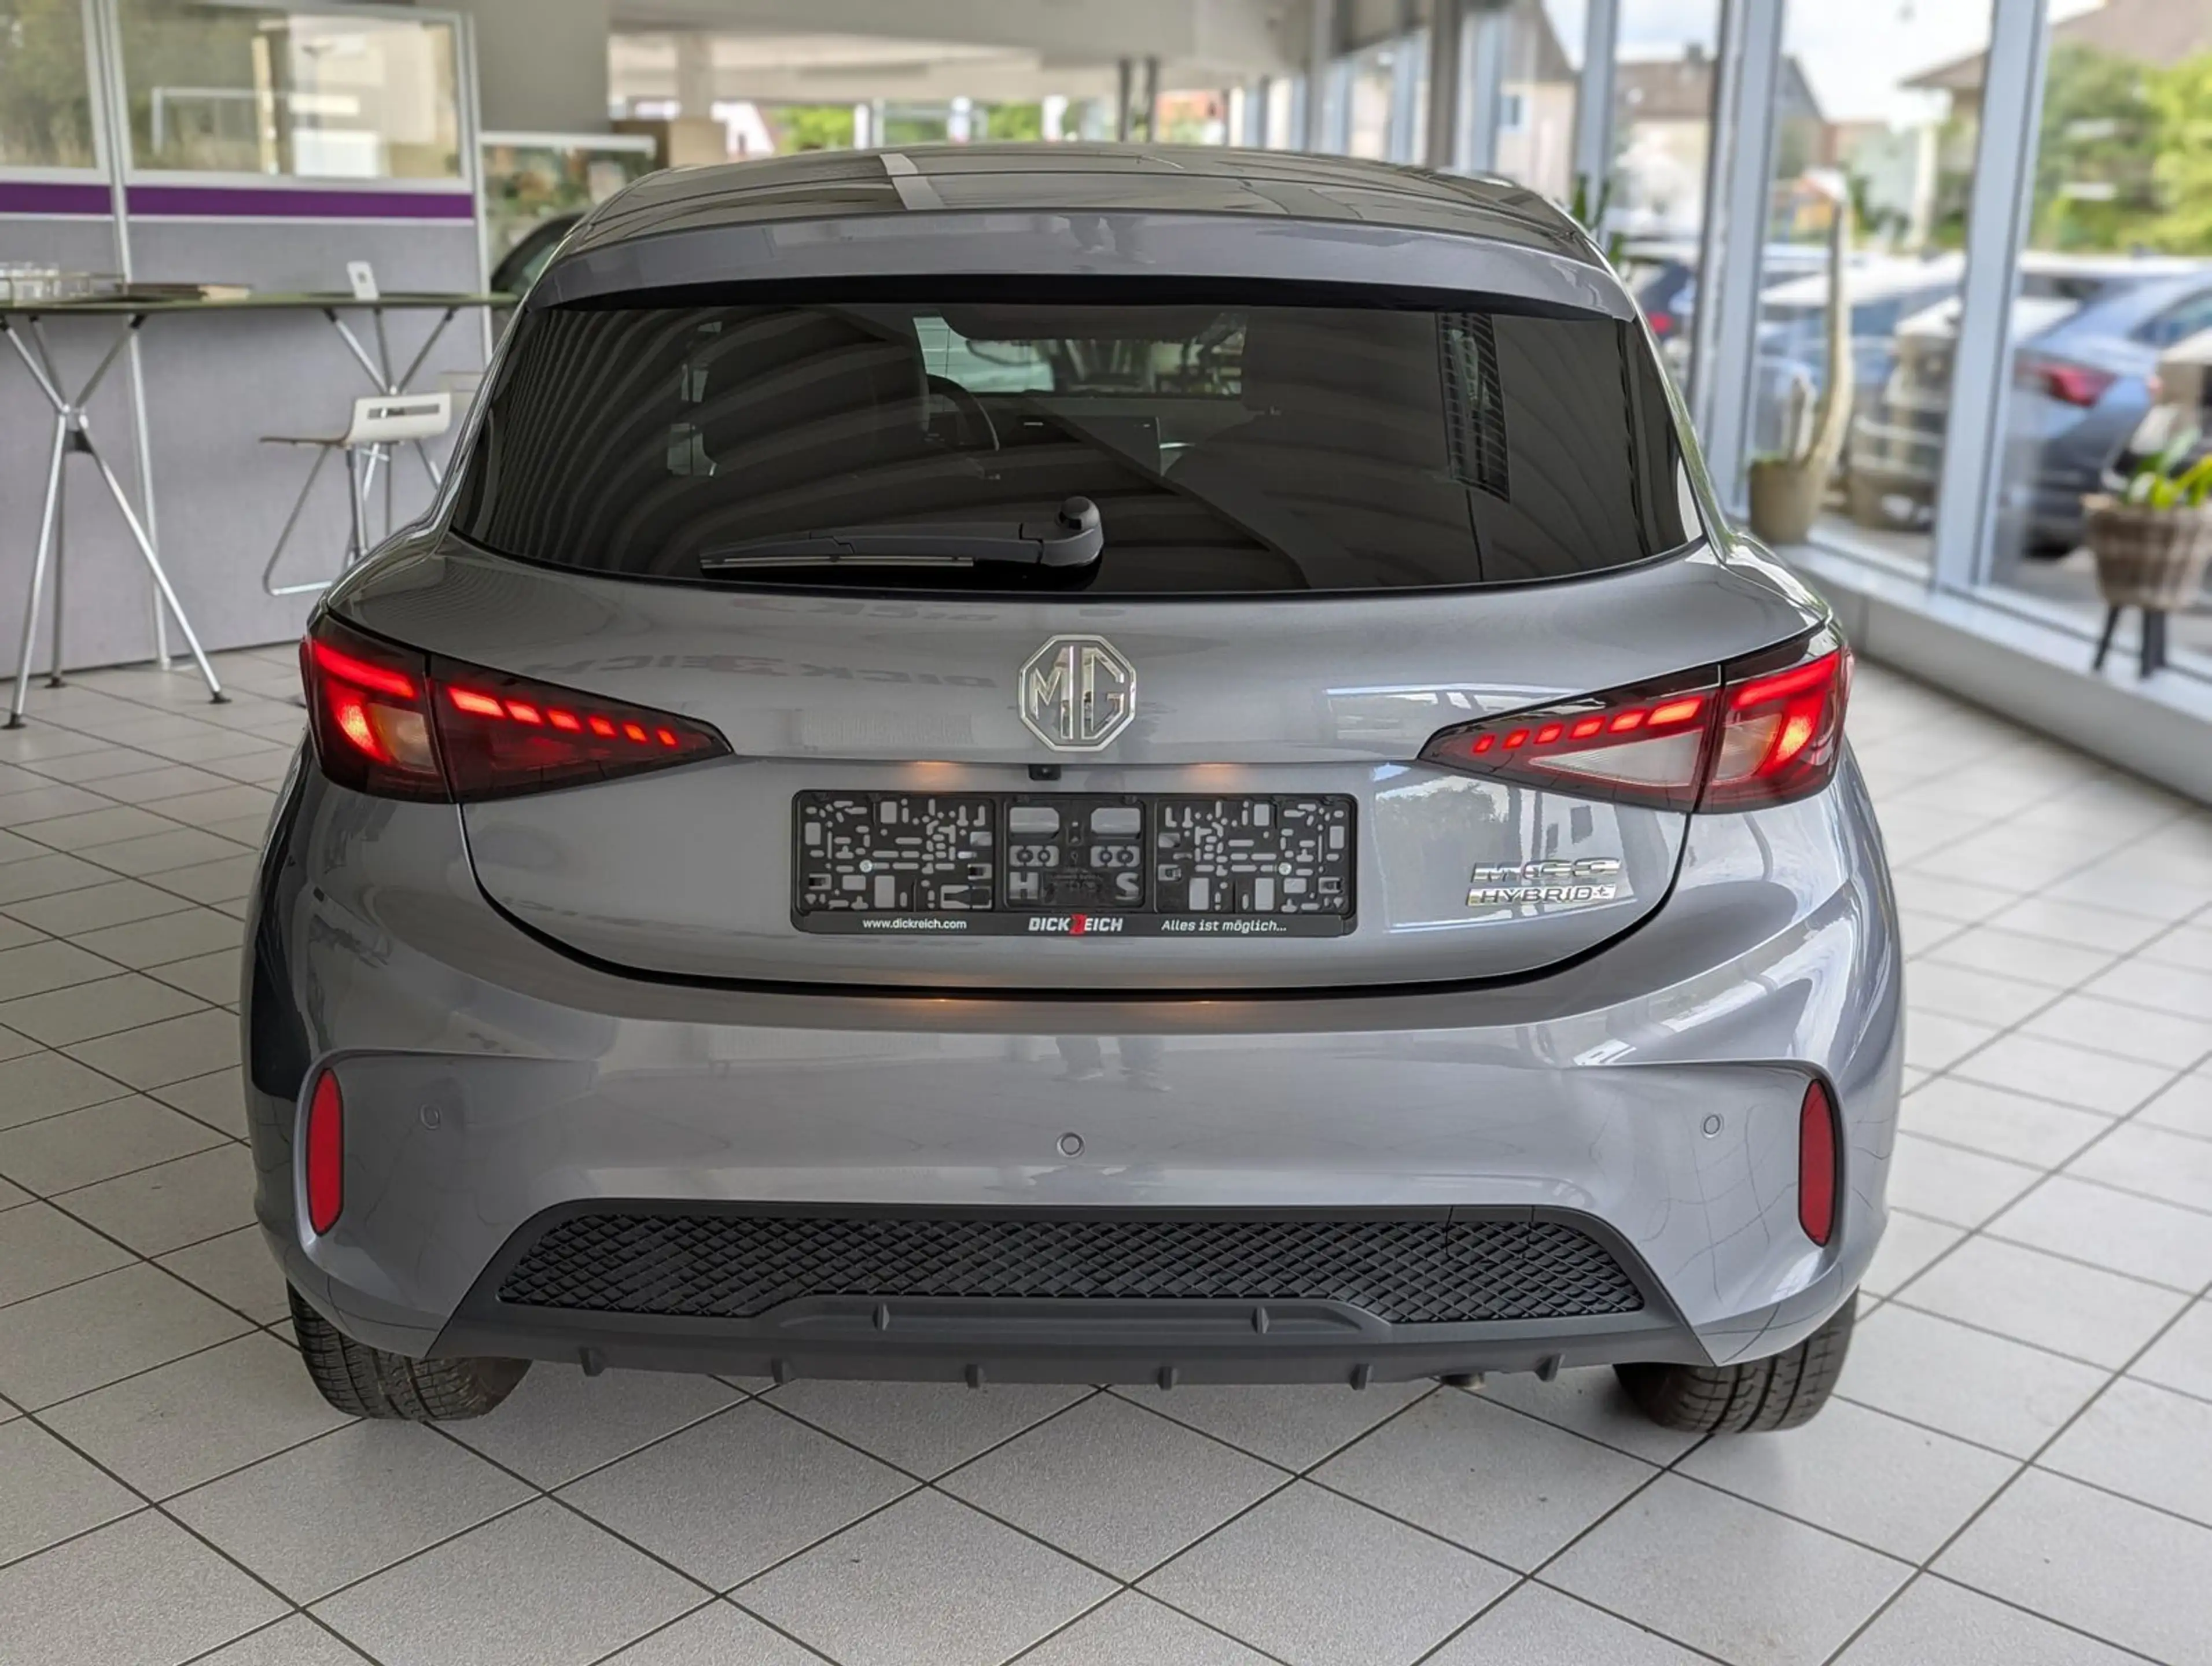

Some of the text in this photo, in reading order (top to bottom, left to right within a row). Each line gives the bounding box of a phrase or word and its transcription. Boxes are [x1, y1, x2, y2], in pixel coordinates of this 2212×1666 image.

[1028, 644, 1125, 740] MG
[1479, 886, 1611, 905] HYBRID+
[862, 918, 967, 929] www.dickreich.com
[1161, 919, 1287, 934] Alles ist möglich...
